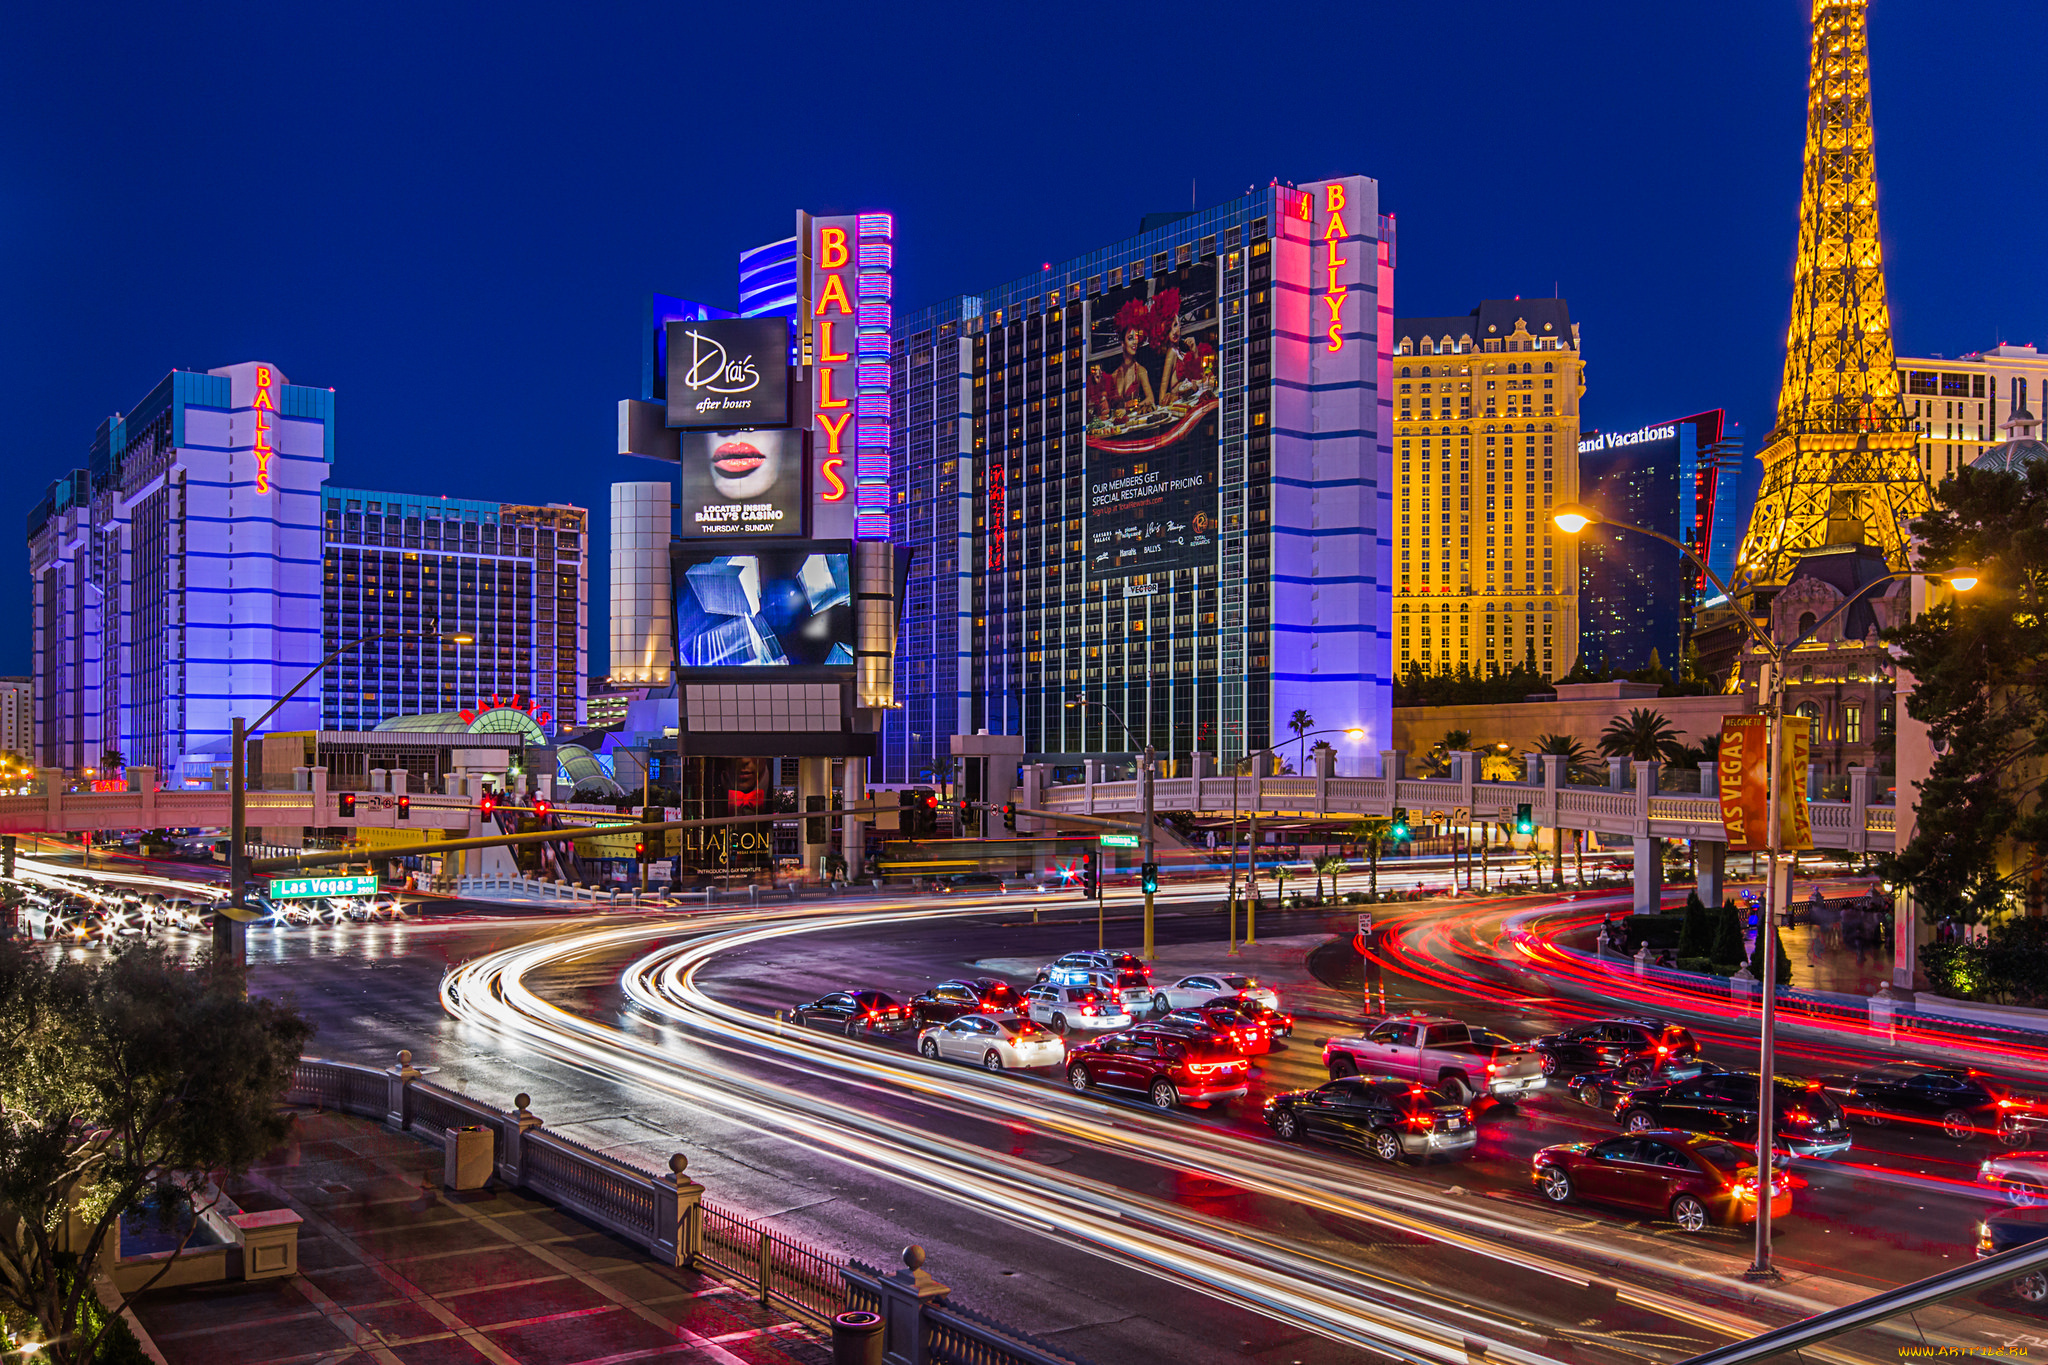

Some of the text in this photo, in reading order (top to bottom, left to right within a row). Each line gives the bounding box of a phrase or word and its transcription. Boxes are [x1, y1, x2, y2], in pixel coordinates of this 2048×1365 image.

[1323, 184, 1349, 352] BALLYS
[685, 329, 760, 393] Drai's
[816, 227, 852, 501] BALLYS
[696, 397, 752, 413] after hours
[253, 366, 274, 494] BALLYS
[1605, 425, 1675, 448] Vacations
[1092, 471, 1160, 495] OUR MEMBERS GET
[1092, 492, 1120, 507] SPECIAL
[1120, 482, 1169, 501] RESTAURANT
[695, 510, 784, 522] BALLY'S CASINO
[703, 503, 773, 513] LOCATED INSIDE
[1092, 508, 1104, 516] Sign
[1104, 506, 1112, 515] Up
[1118, 496, 1164, 510] TotalRewards.com
[702, 524, 740, 532] THURSDAY
[745, 523, 775, 532] SUNDAY
[1130, 584, 1157, 594] VECTOR
[459, 693, 552, 726] BALLYS
[1725, 718, 1761, 727] WELCOME TO
[1793, 733, 1808, 771] LAS
[1721, 731, 1748, 845] LAS VEGAS
[281, 880, 307, 895] Las
[311, 879, 354, 896] Vegas
[357, 877, 374, 885] BLVD
